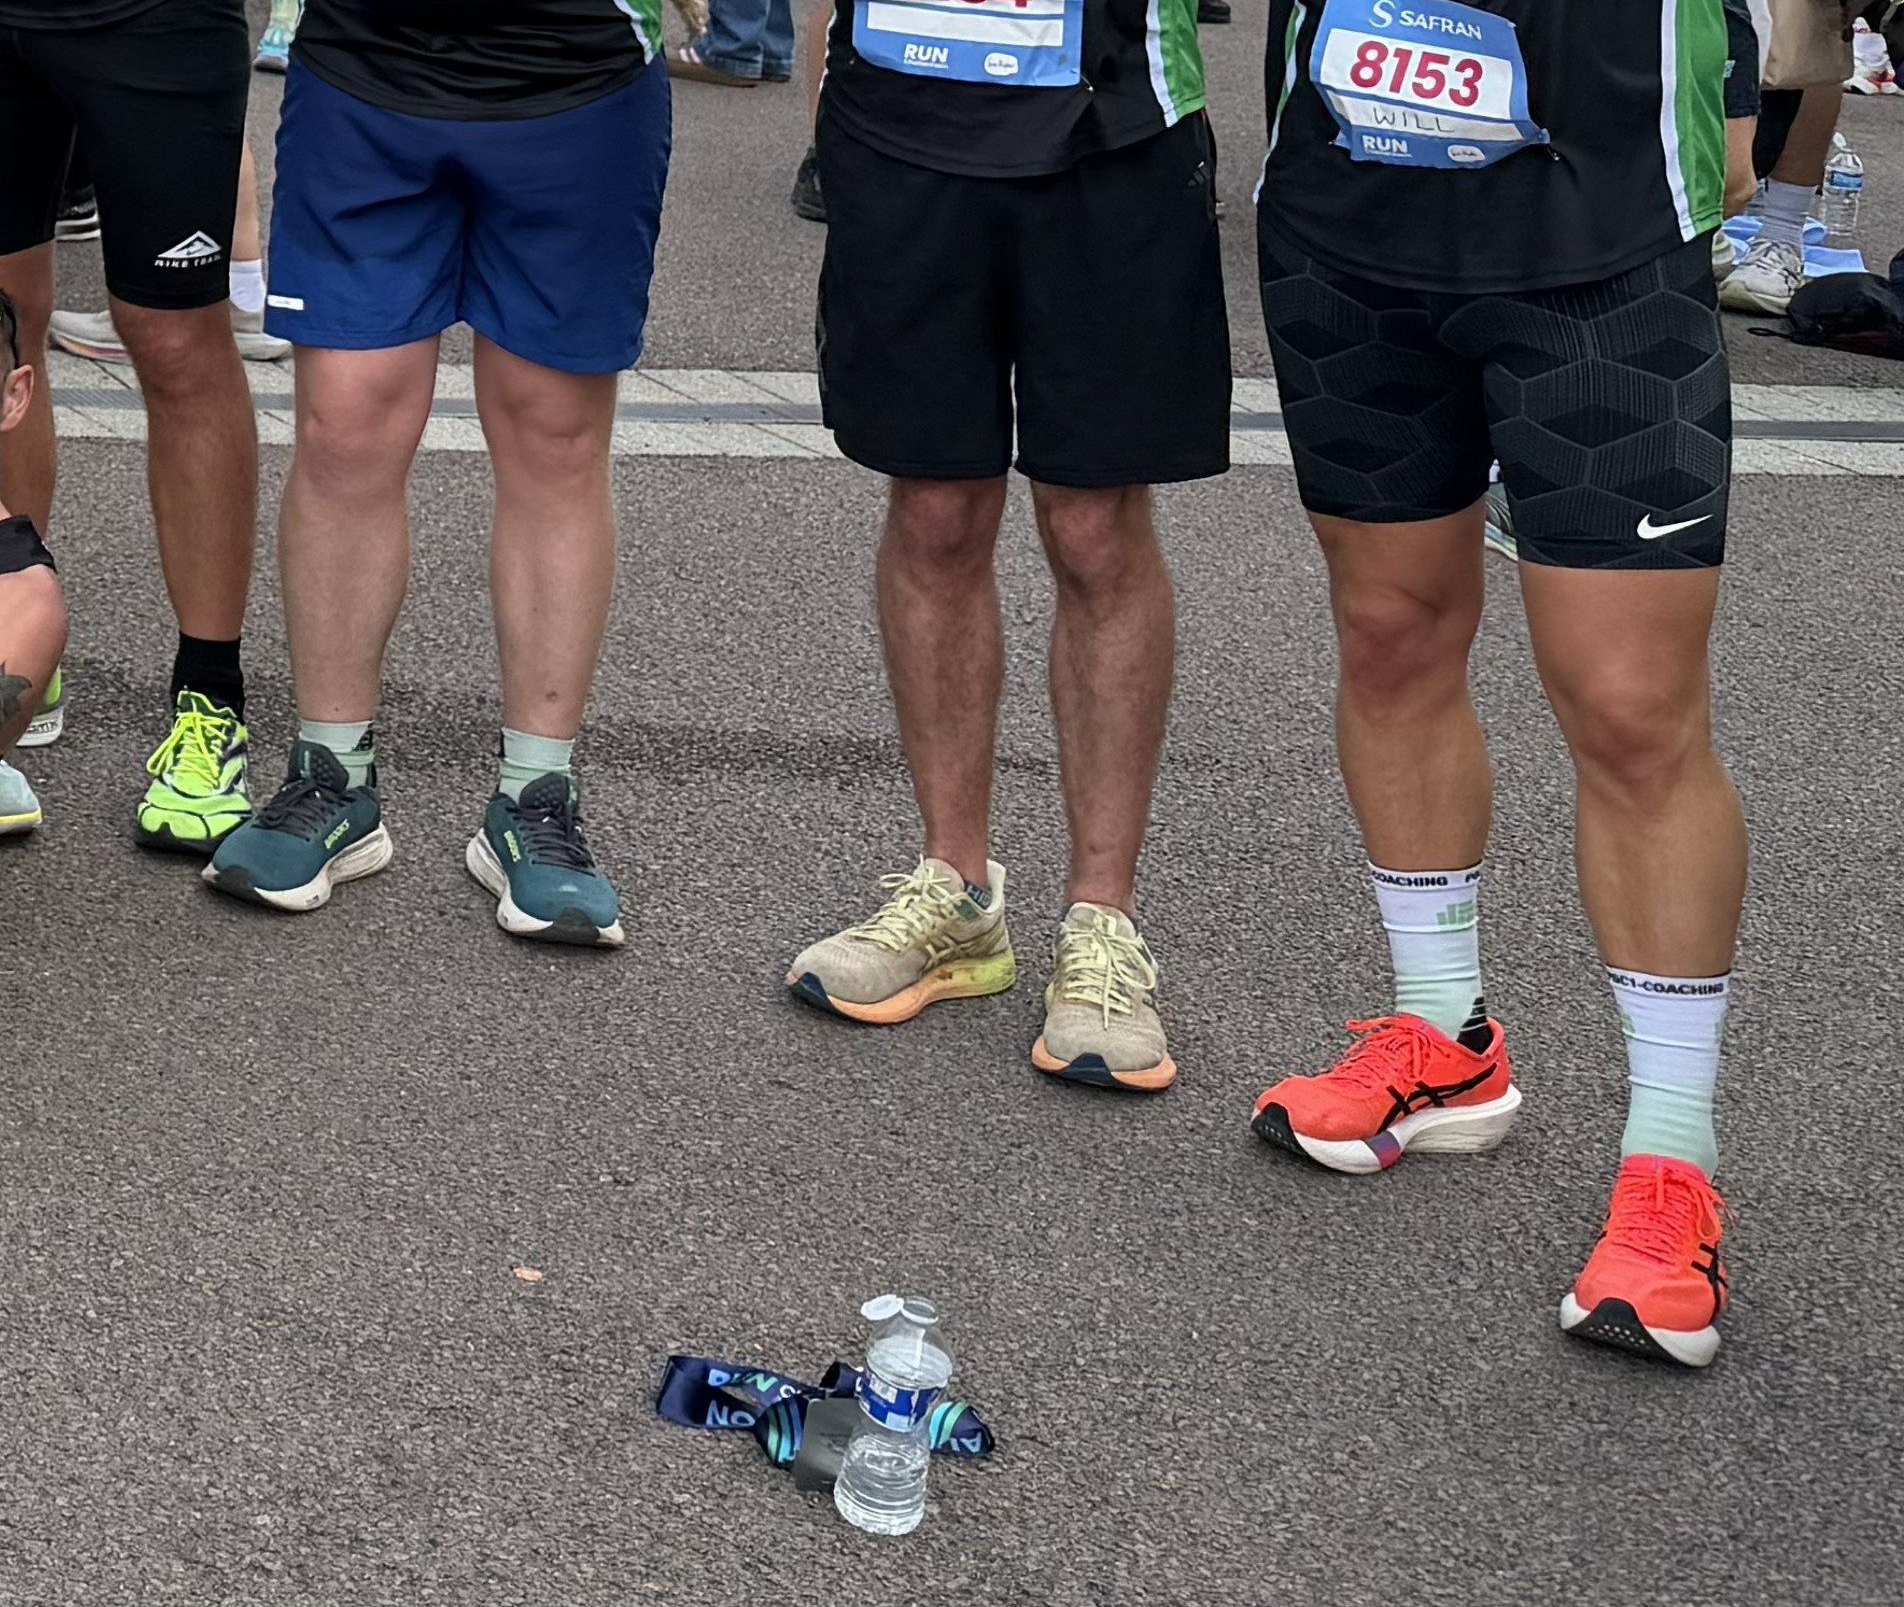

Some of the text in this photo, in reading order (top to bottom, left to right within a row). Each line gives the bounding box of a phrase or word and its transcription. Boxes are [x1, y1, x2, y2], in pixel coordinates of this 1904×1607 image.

[1399, 10, 1482, 40] SAFRAN
[904, 44, 949, 62] RUN
[1350, 40, 1483, 107] 8153
[1373, 107, 1455, 133] WILL
[1362, 135, 1408, 153] RUN
